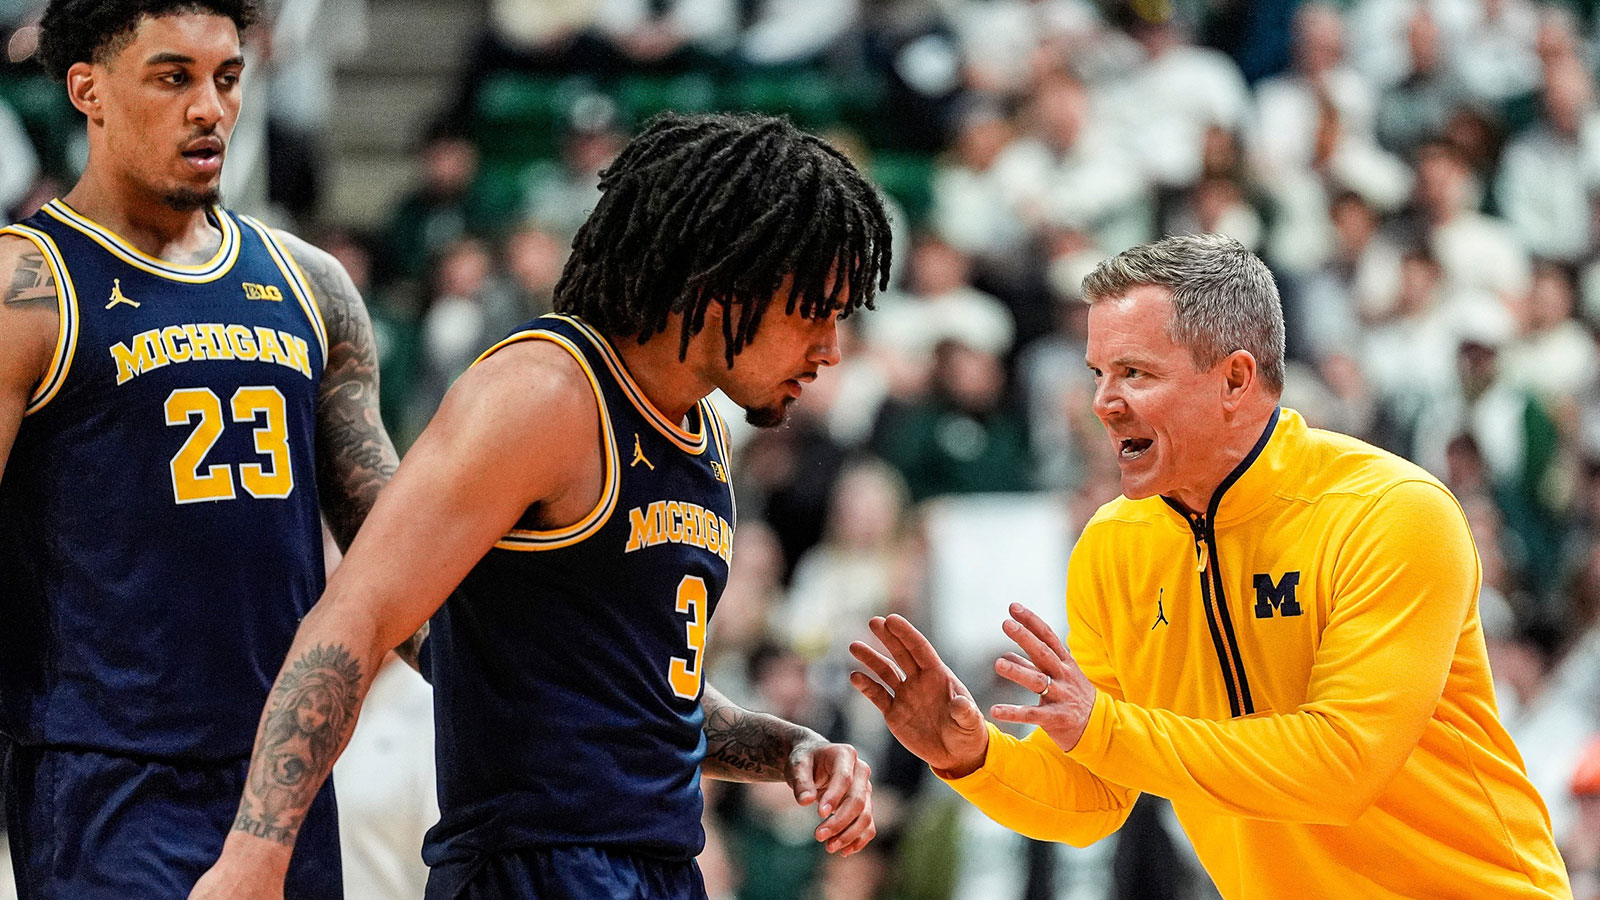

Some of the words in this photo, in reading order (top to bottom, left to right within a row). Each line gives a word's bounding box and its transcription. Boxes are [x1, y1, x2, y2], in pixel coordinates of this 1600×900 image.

[110, 323, 312, 386] MICHIGAN
[164, 385, 294, 504] 23
[625, 500, 733, 568] MICHIGA
[1253, 571, 1300, 618] M
[668, 574, 708, 701] 3
